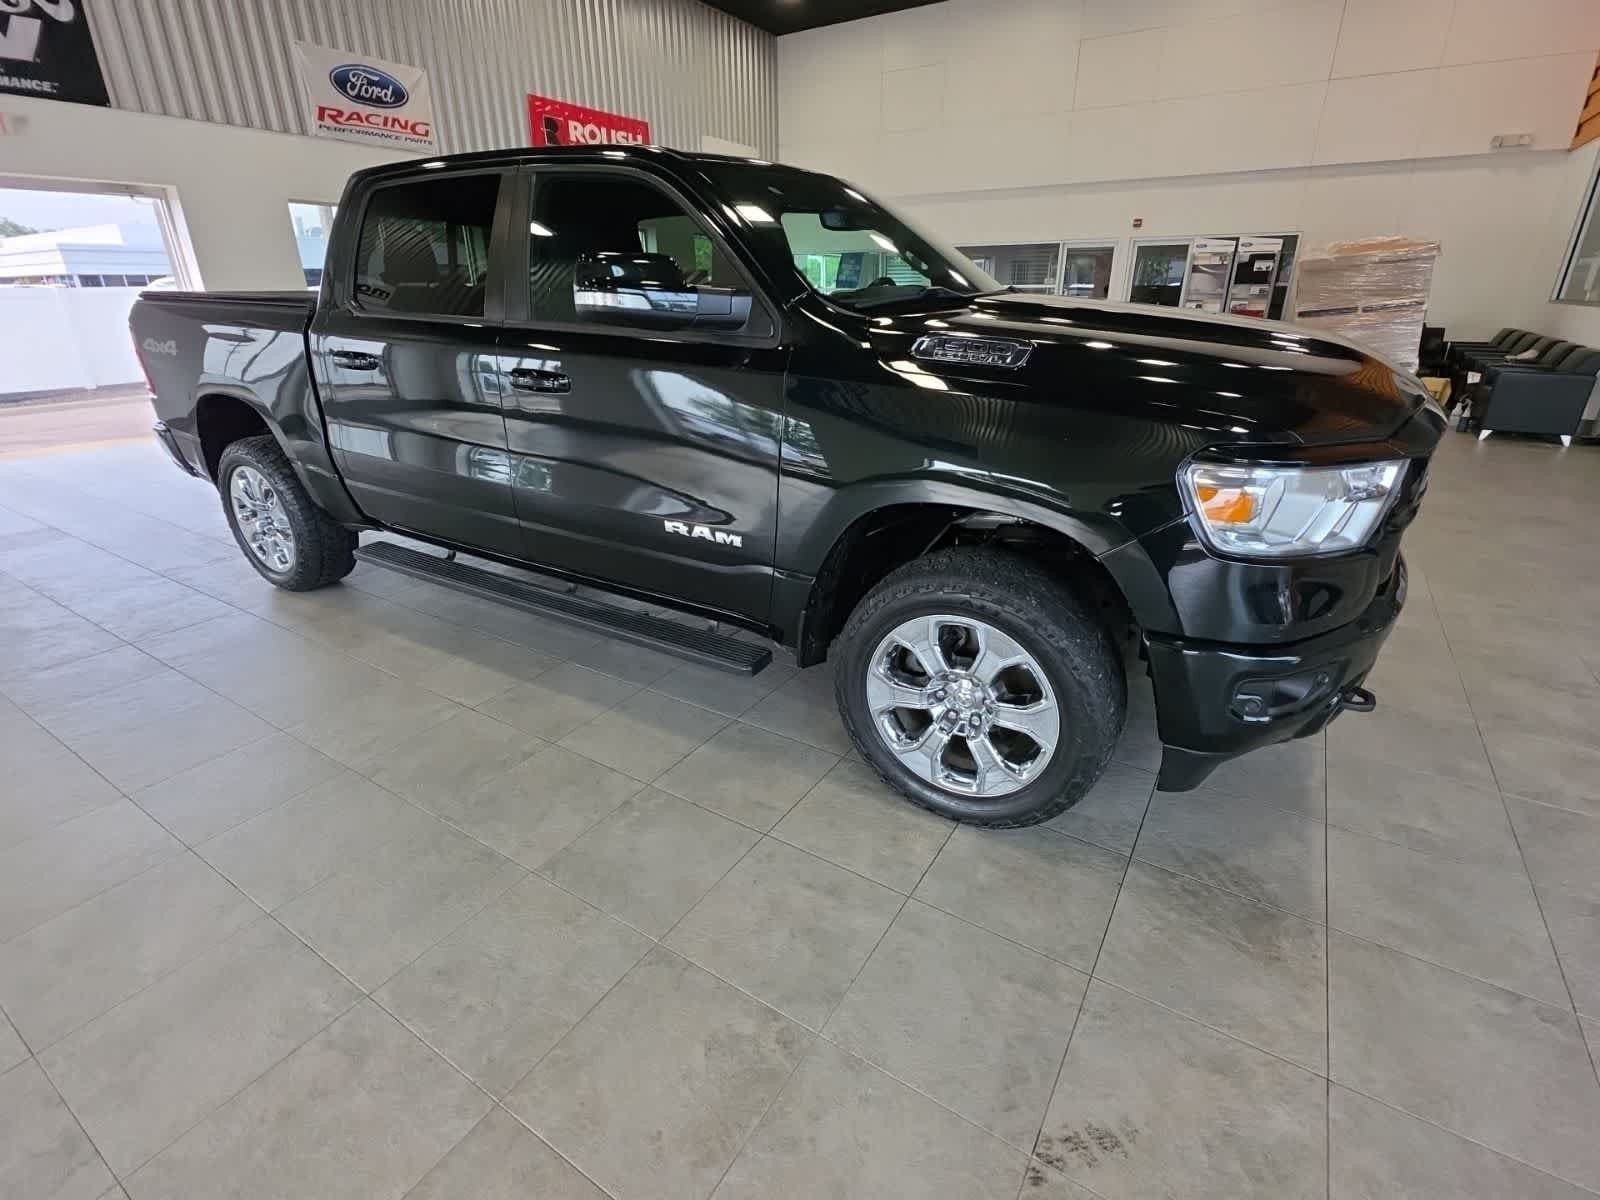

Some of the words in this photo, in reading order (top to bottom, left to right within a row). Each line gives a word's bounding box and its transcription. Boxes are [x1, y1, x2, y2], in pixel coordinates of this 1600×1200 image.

[346, 70, 396, 102] Ford
[317, 105, 430, 138] RACING
[318, 123, 401, 141] PERFORMANCE
[404, 136, 433, 146] PARTS
[567, 120, 643, 144] ROUSH
[664, 519, 743, 548] RAM
